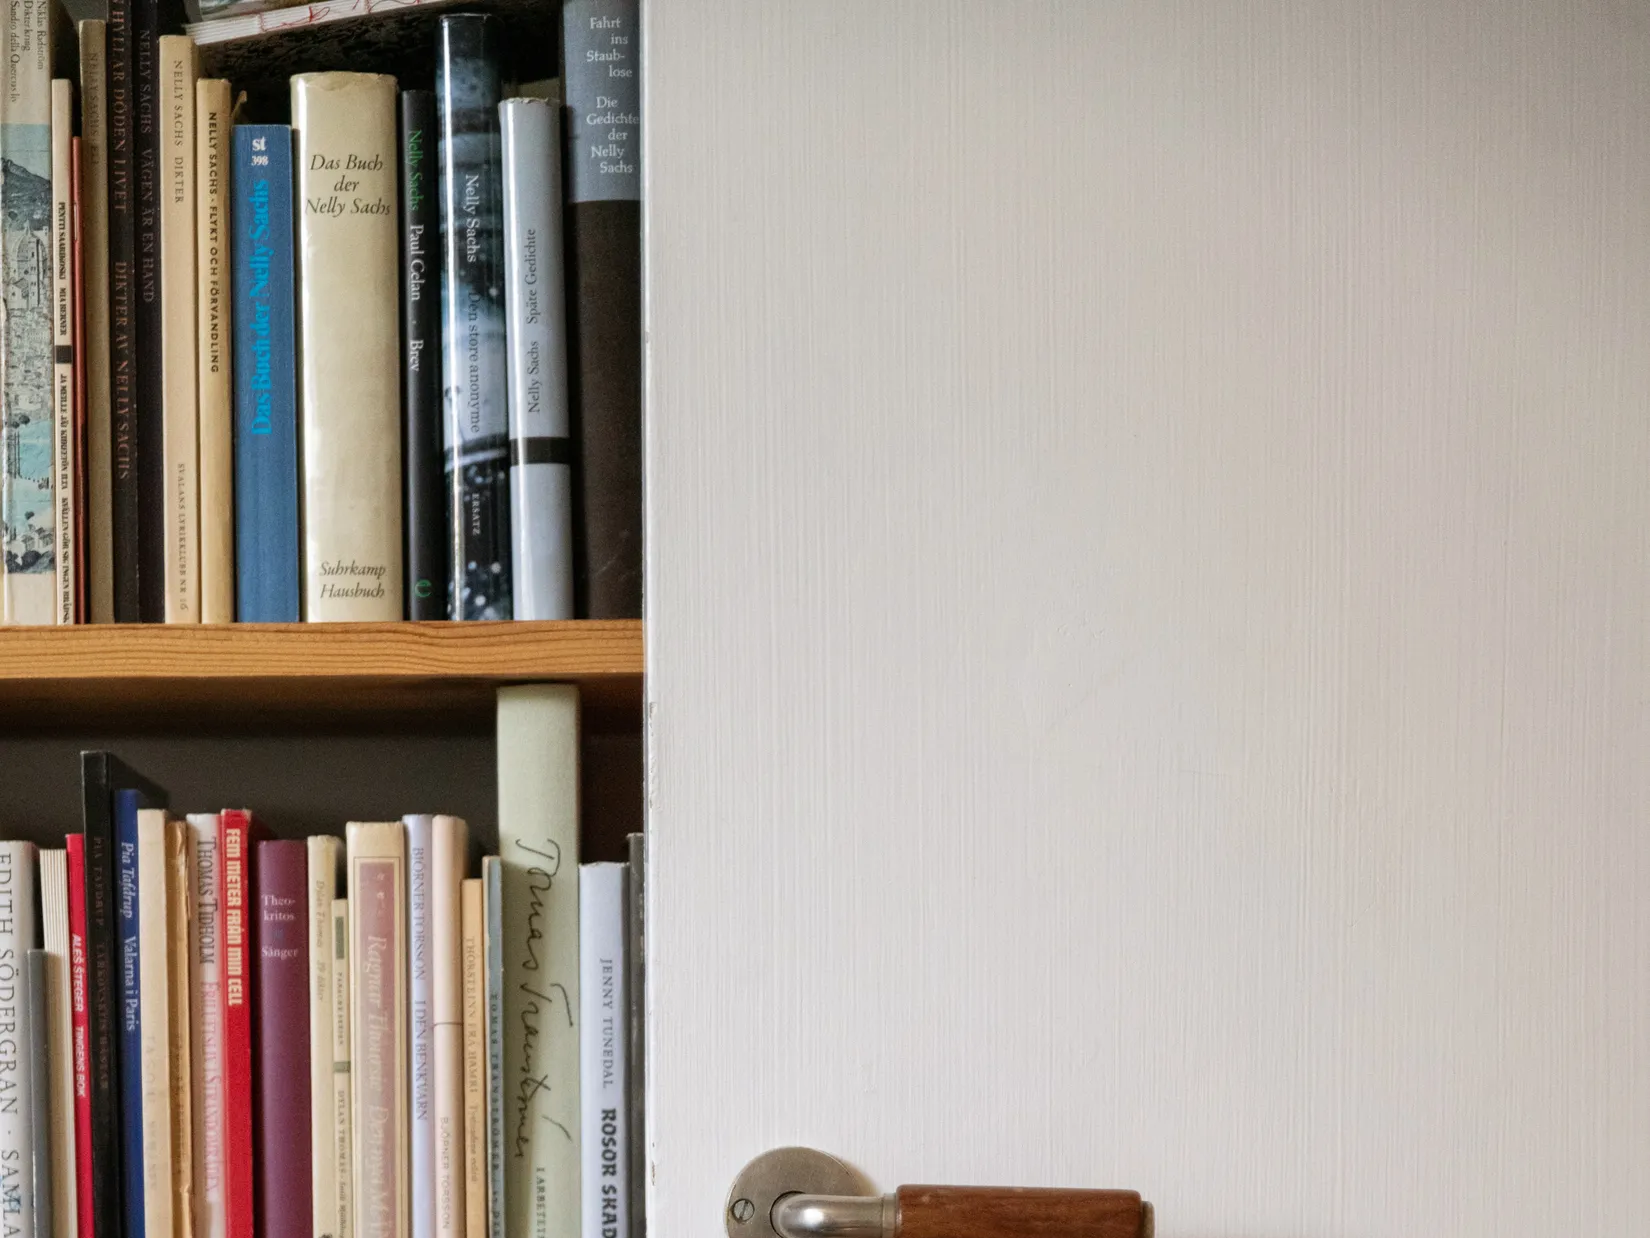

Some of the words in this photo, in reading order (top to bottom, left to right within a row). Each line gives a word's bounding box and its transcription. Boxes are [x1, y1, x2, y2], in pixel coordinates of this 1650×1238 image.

[10, 0, 20, 30] Sandro
[24, 0, 34, 28] Dikter
[36, 0, 47, 28] Niklas
[590, 16, 621, 29] Fahrt
[10, 32, 21, 52] della
[21, 29, 34, 51] kring
[36, 30, 47, 70] Radström
[112, 10, 125, 81] HYLLAR
[139, 29, 151, 79] NELLY
[586, 49, 625, 62] Staub-
[611, 34, 628, 45] ins
[173, 60, 183, 101] NELLY
[609, 65, 633, 78] lose
[140, 83, 152, 133] SACHS
[586, 113, 640, 125] Gedichte
[596, 96, 618, 108] Die
[112, 89, 128, 152] DÖDEN
[174, 104, 184, 147] SACHS
[208, 112, 218, 150] NELLY
[608, 129, 628, 140] der
[250, 155, 269, 166] 398
[251, 136, 266, 151] st
[404, 129, 424, 167] Nelly
[591, 146, 625, 159] Nelly
[141, 148, 154, 203] VÄGEN
[174, 156, 184, 204] DIKTER
[209, 153, 218, 195] SACHS
[310, 154, 340, 171] Das
[345, 153, 383, 171] Buch
[600, 162, 633, 173] Sachs
[114, 160, 127, 216] LIVET
[333, 175, 360, 192] der
[408, 172, 424, 211] Sachs
[462, 173, 480, 215] Nelly
[141, 207, 155, 229] ÄR
[209, 206, 218, 243] FLYKT
[248, 179, 270, 241] Sachs
[305, 196, 345, 217] Nelly
[350, 196, 391, 215] Sachs
[142, 232, 153, 253] EN
[409, 224, 425, 255] Paul
[465, 217, 481, 263] Sachs
[523, 228, 538, 286] Gedichte
[209, 246, 219, 276] OCH
[249, 245, 274, 298] Nelly
[115, 261, 128, 327] DIKTER
[142, 258, 154, 303] HAND
[409, 259, 426, 302] Celan
[251, 302, 270, 335] der
[467, 292, 482, 321] Den
[525, 289, 541, 325] Späte
[116, 332, 129, 351] AV
[210, 280, 221, 374] FÖRVANDLING
[468, 324, 481, 362] store
[251, 340, 271, 390] Buch
[409, 339, 424, 372] Brev
[525, 341, 540, 375] Sachs
[116, 360, 129, 419] NELLY
[466, 364, 481, 433] anonyme
[526, 378, 542, 414] Nelly
[250, 393, 272, 434] Das
[118, 421, 130, 480] SACHS
[178, 463, 186, 510] SVALANS
[472, 493, 480, 536] ERSATZ
[179, 579, 187, 593] NR
[319, 560, 386, 579] Suhrkamp
[320, 582, 385, 599] Hausbuch
[121, 842, 135, 864] Pia
[226, 828, 241, 858] FEM
[197, 837, 217, 897] THOMAS
[227, 860, 242, 907] METER
[0, 853, 14, 935] EDITH
[119, 867, 136, 919] Tafdrup
[198, 898, 219, 965] TIDHOLM
[227, 909, 245, 945] FRÅN
[263, 910, 295, 921] kritos
[123, 936, 138, 986] Valarna
[227, 947, 242, 976] MIN
[261, 945, 298, 960] Sånger
[228, 978, 242, 1006] CELL
[600, 958, 613, 1010] JENNY
[0, 948, 20, 1115] SÖDERGRAN
[125, 998, 139, 1032] Paris
[414, 1008, 428, 1040] DEN
[602, 1016, 614, 1089] TUNEDAL
[77, 1075, 86, 1098] BOK
[601, 1107, 618, 1177] ROSOR
